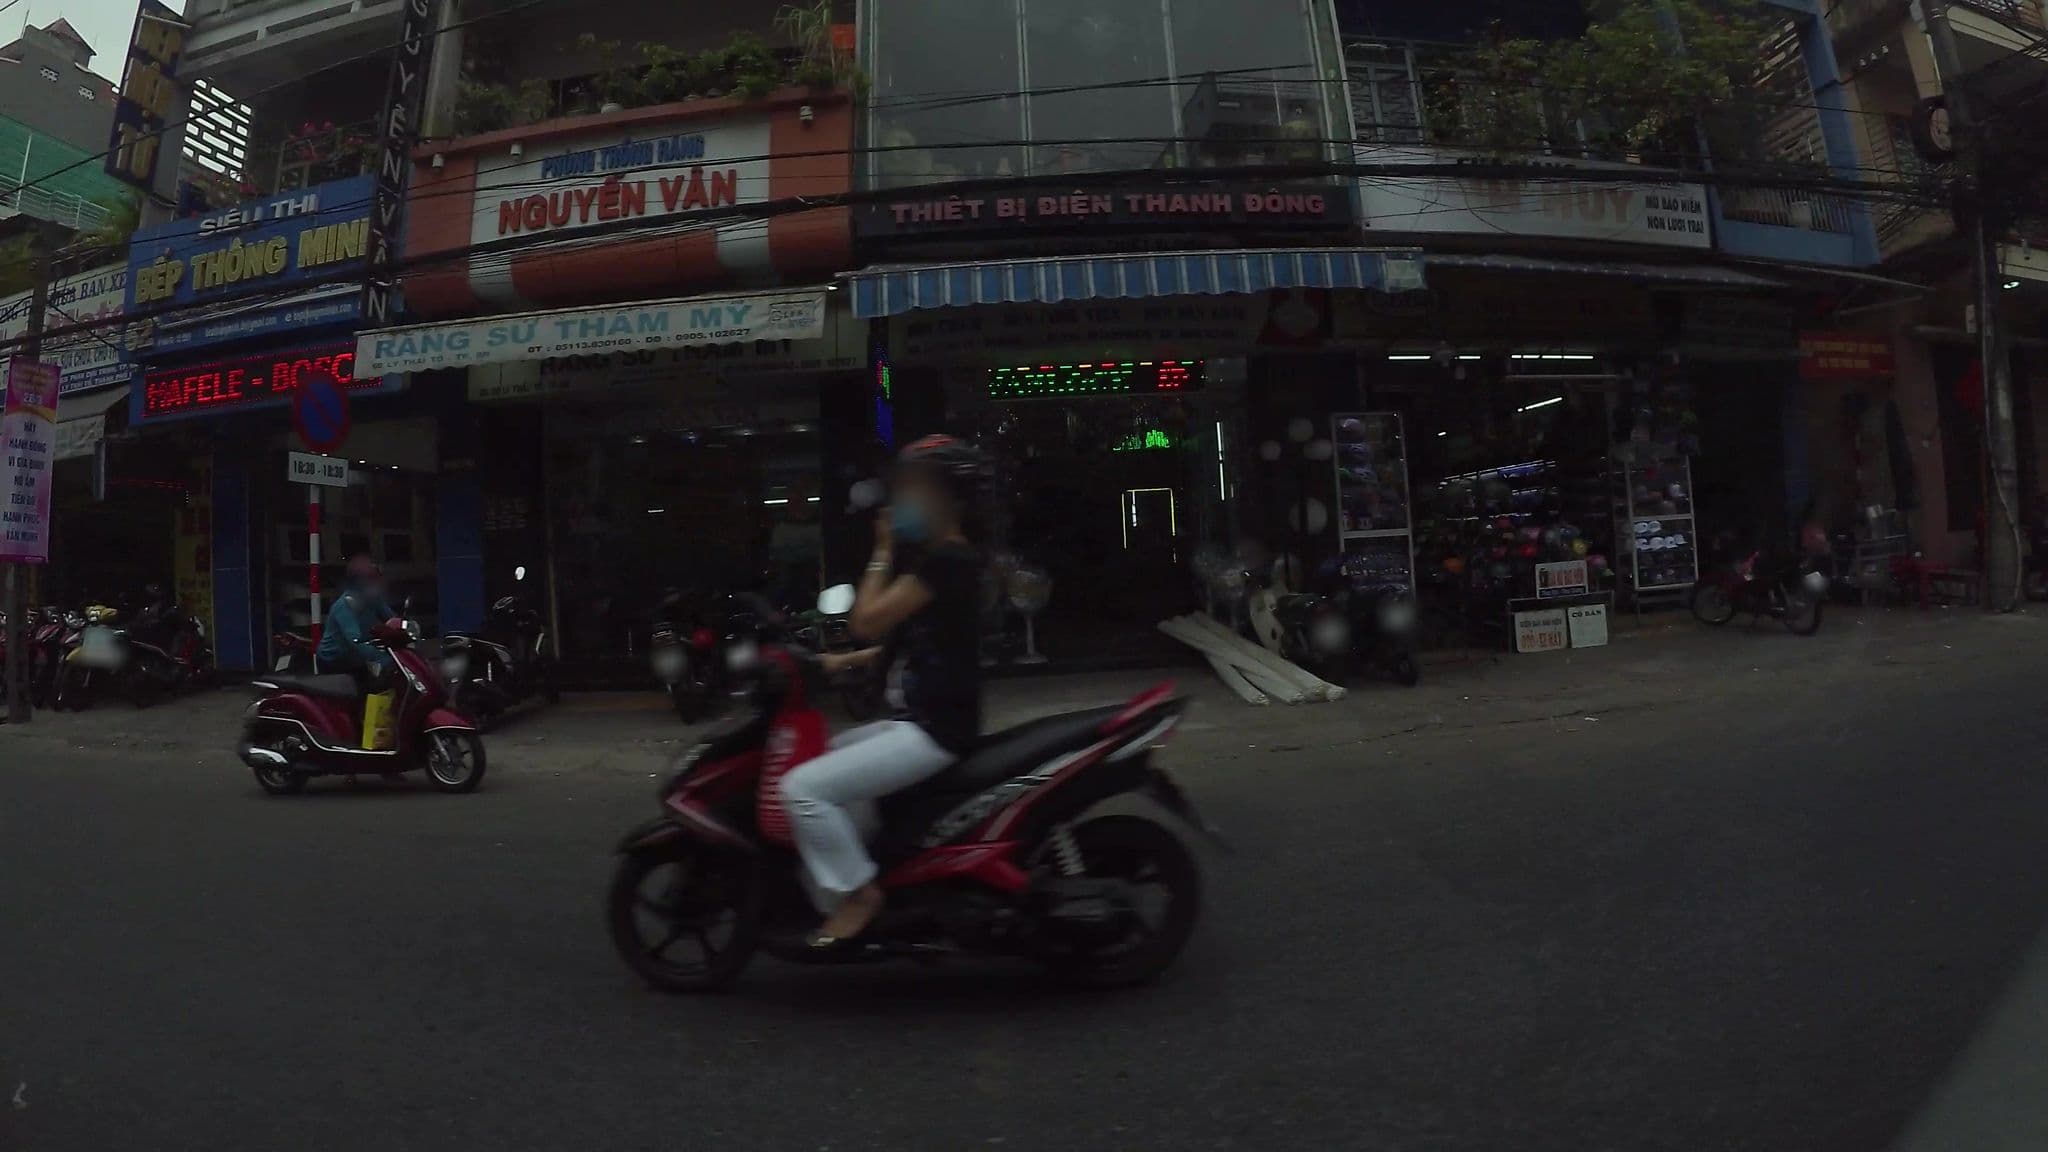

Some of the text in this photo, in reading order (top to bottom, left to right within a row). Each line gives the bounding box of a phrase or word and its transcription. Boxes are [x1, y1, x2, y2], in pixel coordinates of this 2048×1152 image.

[996, 197, 1026, 223] BỊ
[1038, 189, 1113, 220] ĐIỆN
[135, 247, 185, 304] BẾP
[190, 235, 289, 291] THÔNG
